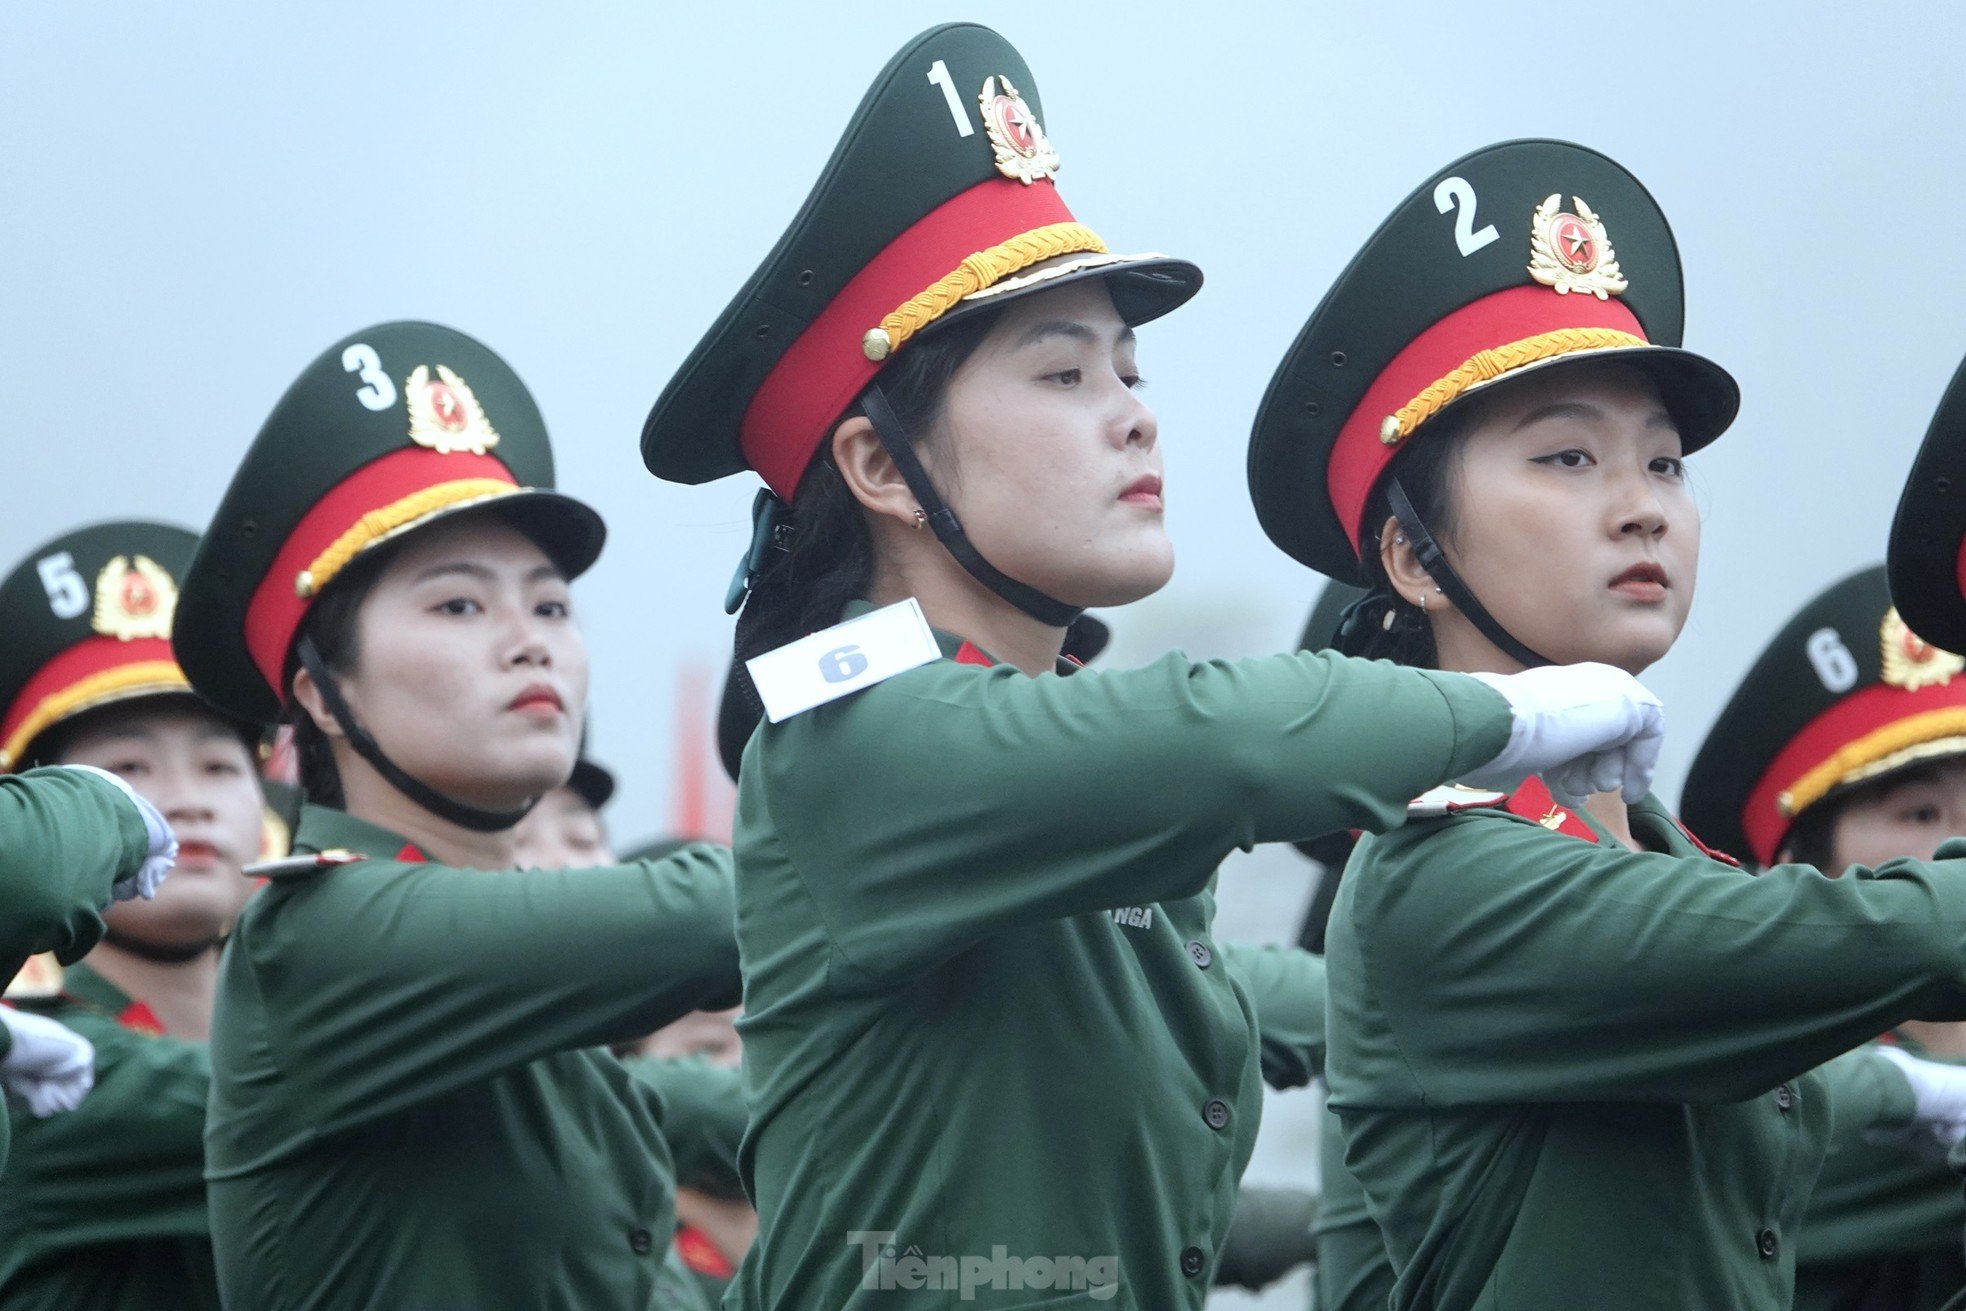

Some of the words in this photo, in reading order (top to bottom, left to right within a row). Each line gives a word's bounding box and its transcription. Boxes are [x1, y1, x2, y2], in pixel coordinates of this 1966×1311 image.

[926, 60, 974, 137] 1
[1433, 176, 1500, 257] 2
[342, 344, 397, 411] 3
[37, 552, 90, 619] 5
[818, 645, 868, 683] 6
[1807, 628, 1859, 693] 6
[1114, 907, 1152, 929] NGA
